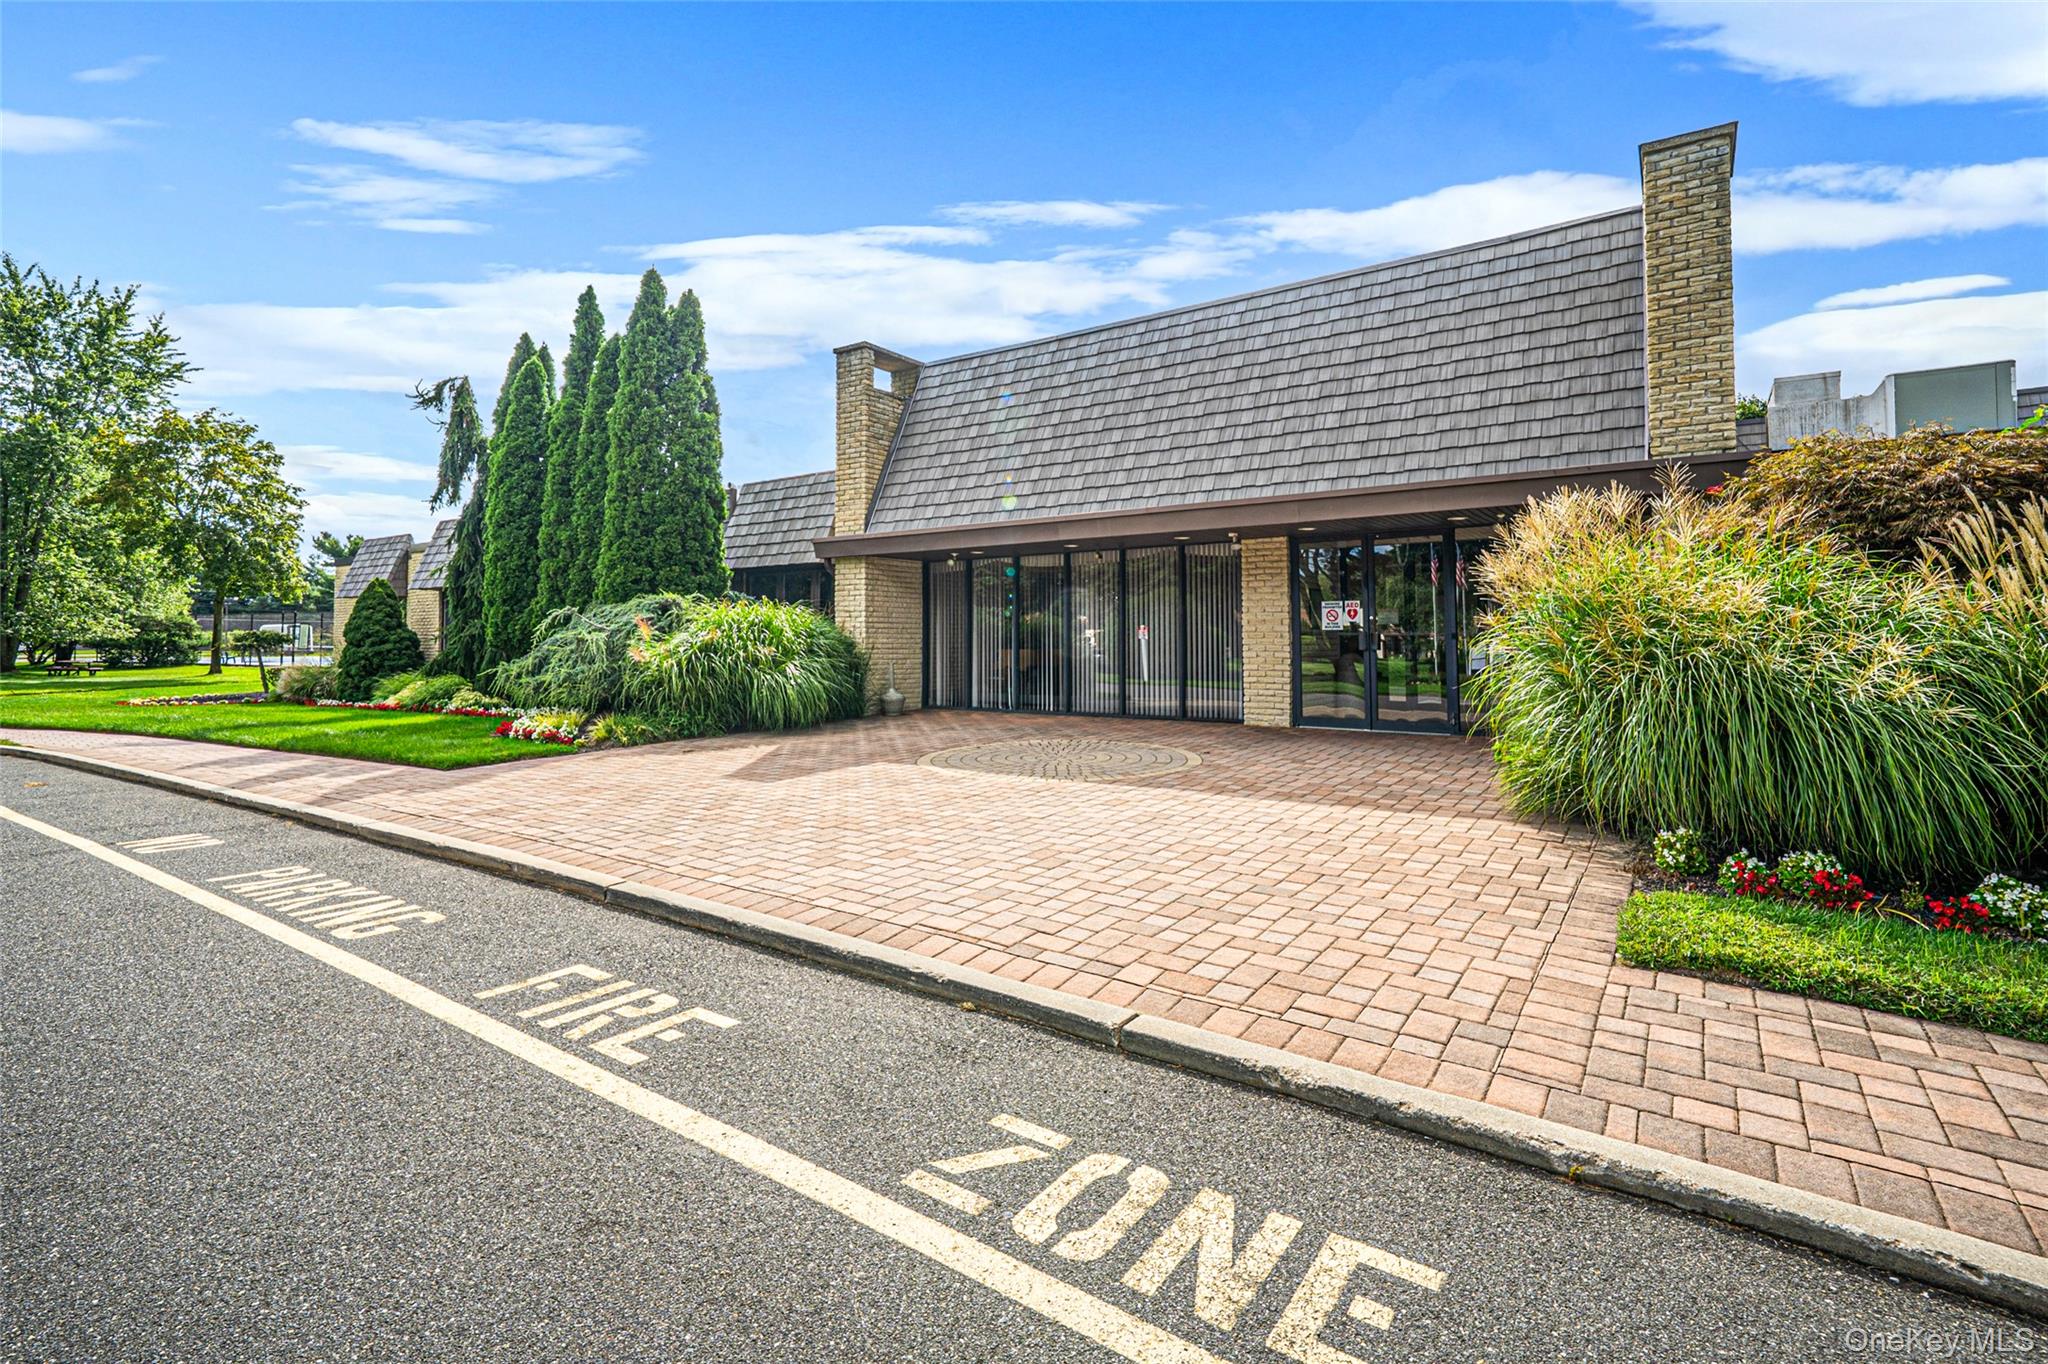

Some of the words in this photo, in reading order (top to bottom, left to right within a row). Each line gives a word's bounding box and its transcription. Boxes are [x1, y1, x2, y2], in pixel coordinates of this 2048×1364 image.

[206, 865, 447, 940] PARKING
[473, 963, 741, 1066] FIRE
[899, 1112, 1448, 1364] ZONE
